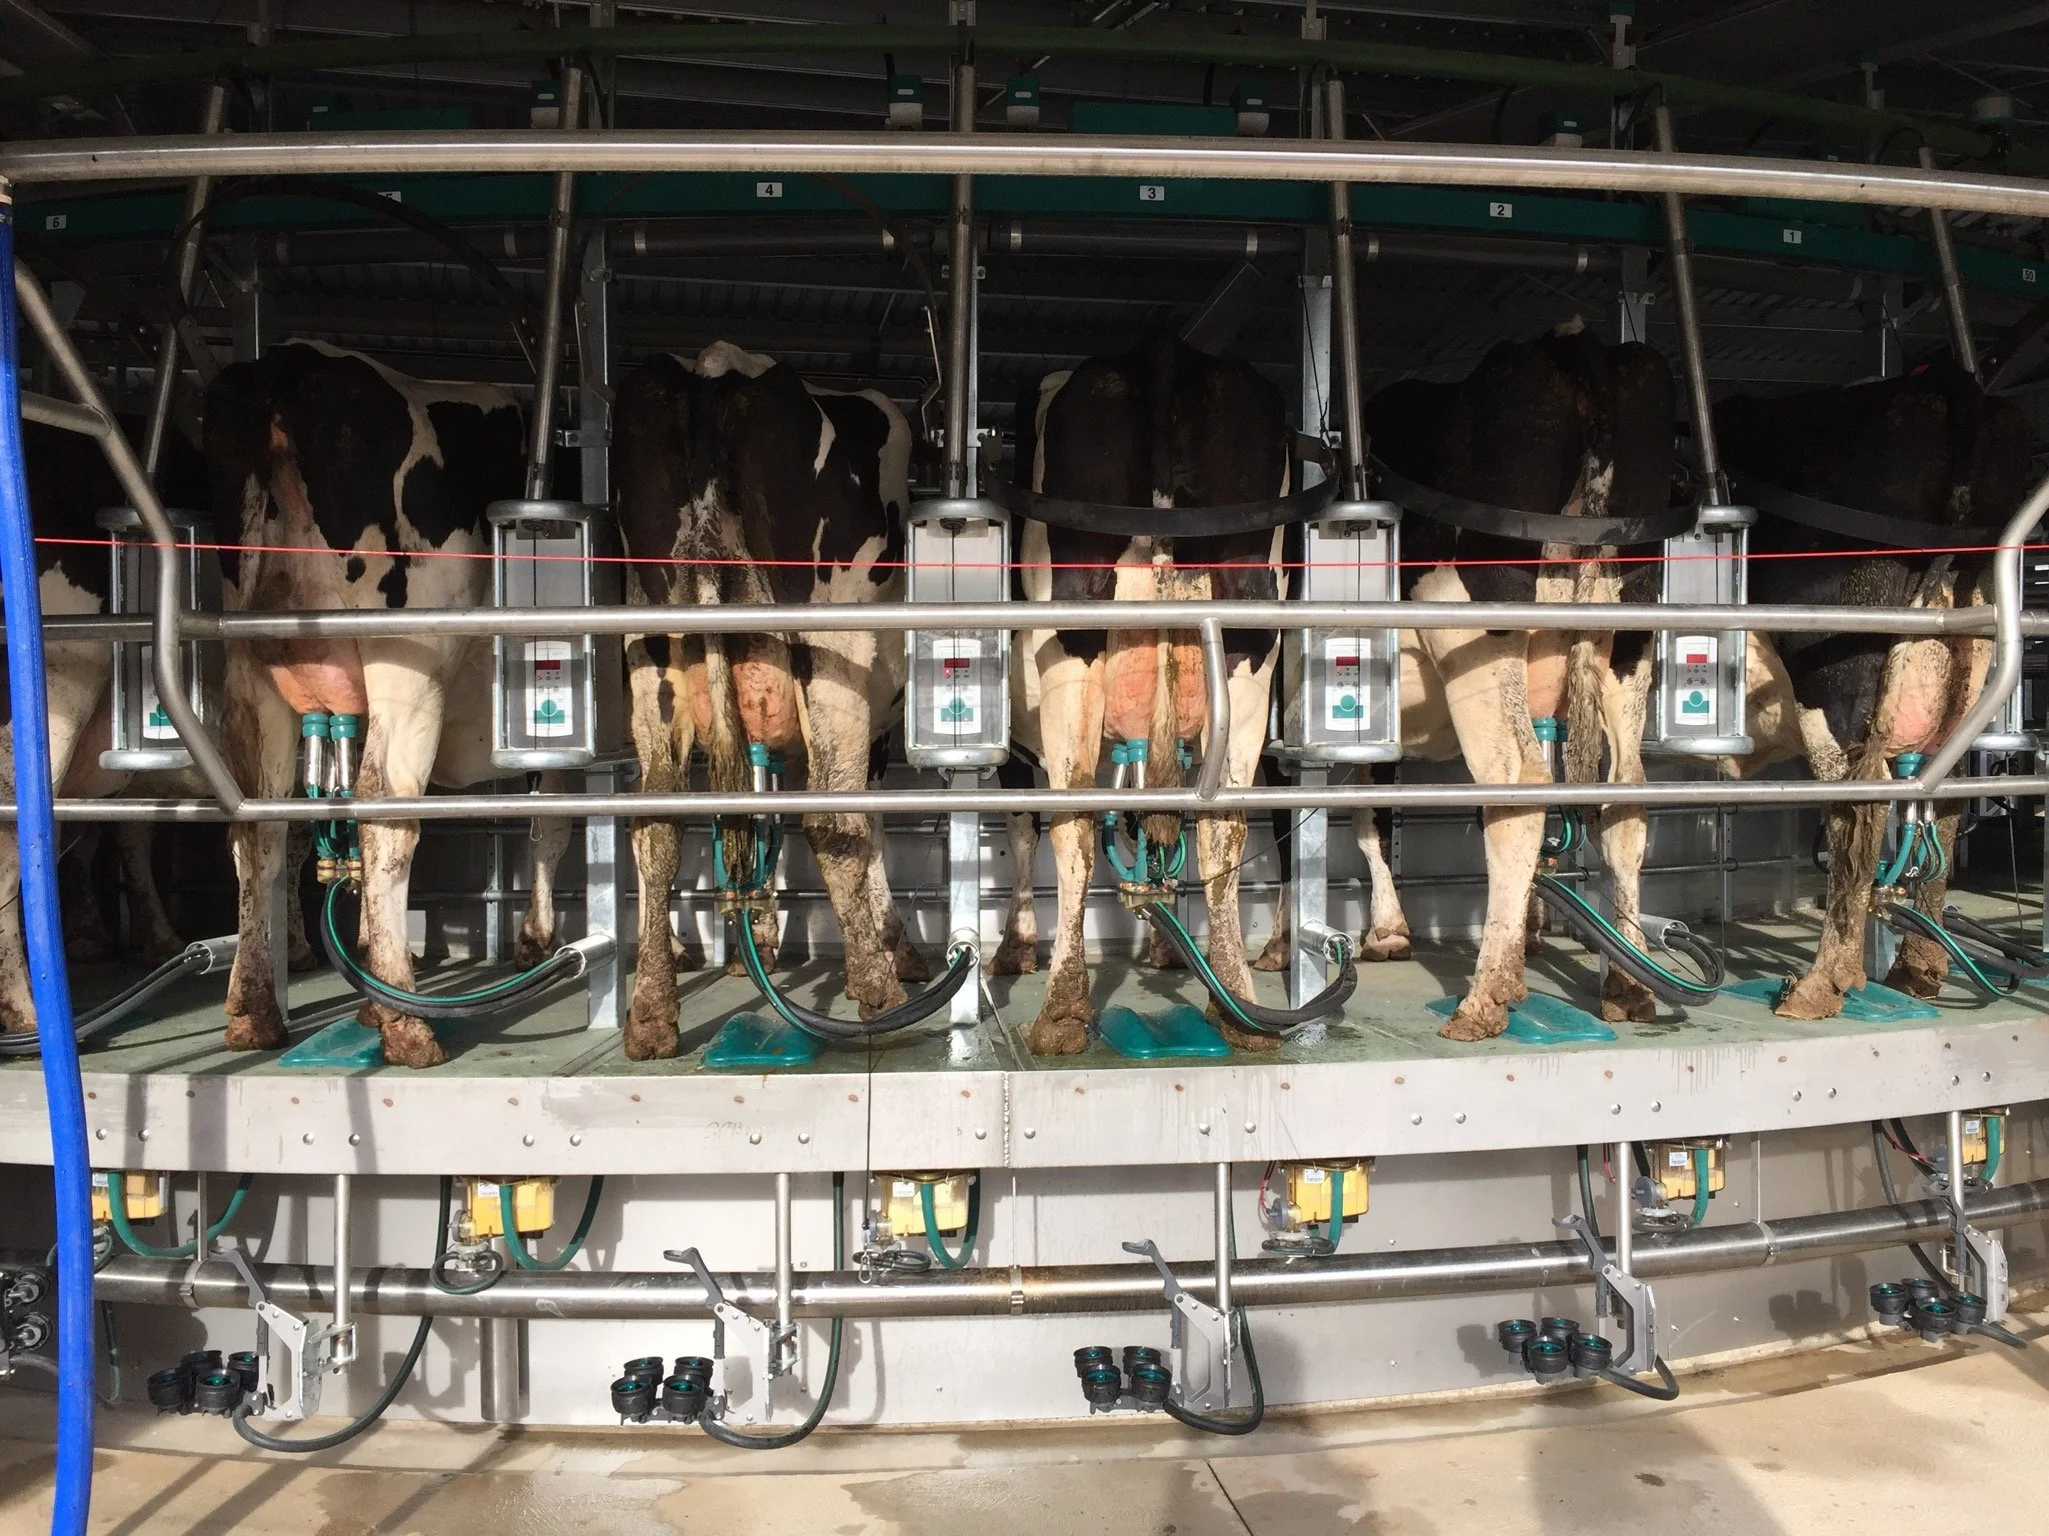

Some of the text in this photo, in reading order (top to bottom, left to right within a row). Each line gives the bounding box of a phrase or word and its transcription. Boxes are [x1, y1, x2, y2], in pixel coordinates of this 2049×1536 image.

[765, 184, 773, 195] 4
[1147, 187, 1157, 199] 3
[1496, 204, 1505, 216] 2
[52, 216, 60, 227] 6
[1788, 231, 1795, 242] 1
